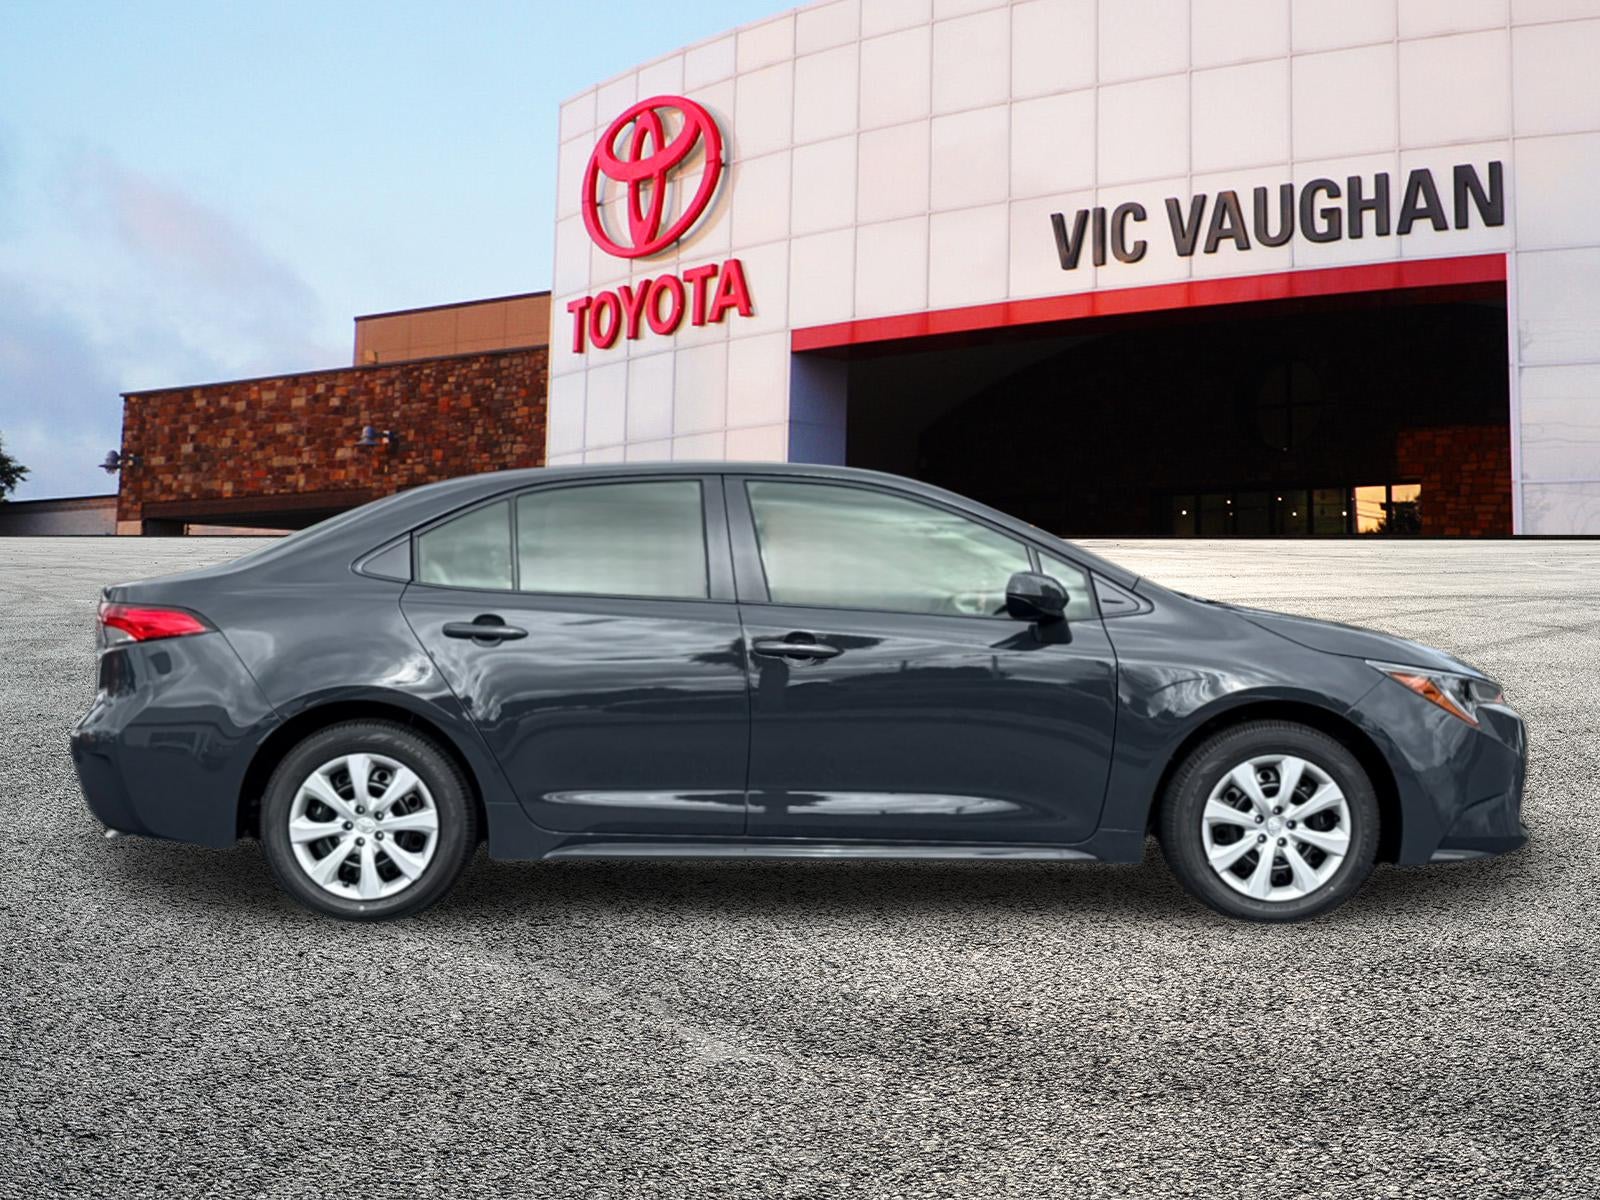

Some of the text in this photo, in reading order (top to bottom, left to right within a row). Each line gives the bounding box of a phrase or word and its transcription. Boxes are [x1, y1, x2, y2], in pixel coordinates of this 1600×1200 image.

[1050, 161, 1504, 270] VIC VAUGHAN
[567, 258, 754, 353] TOYOTA
